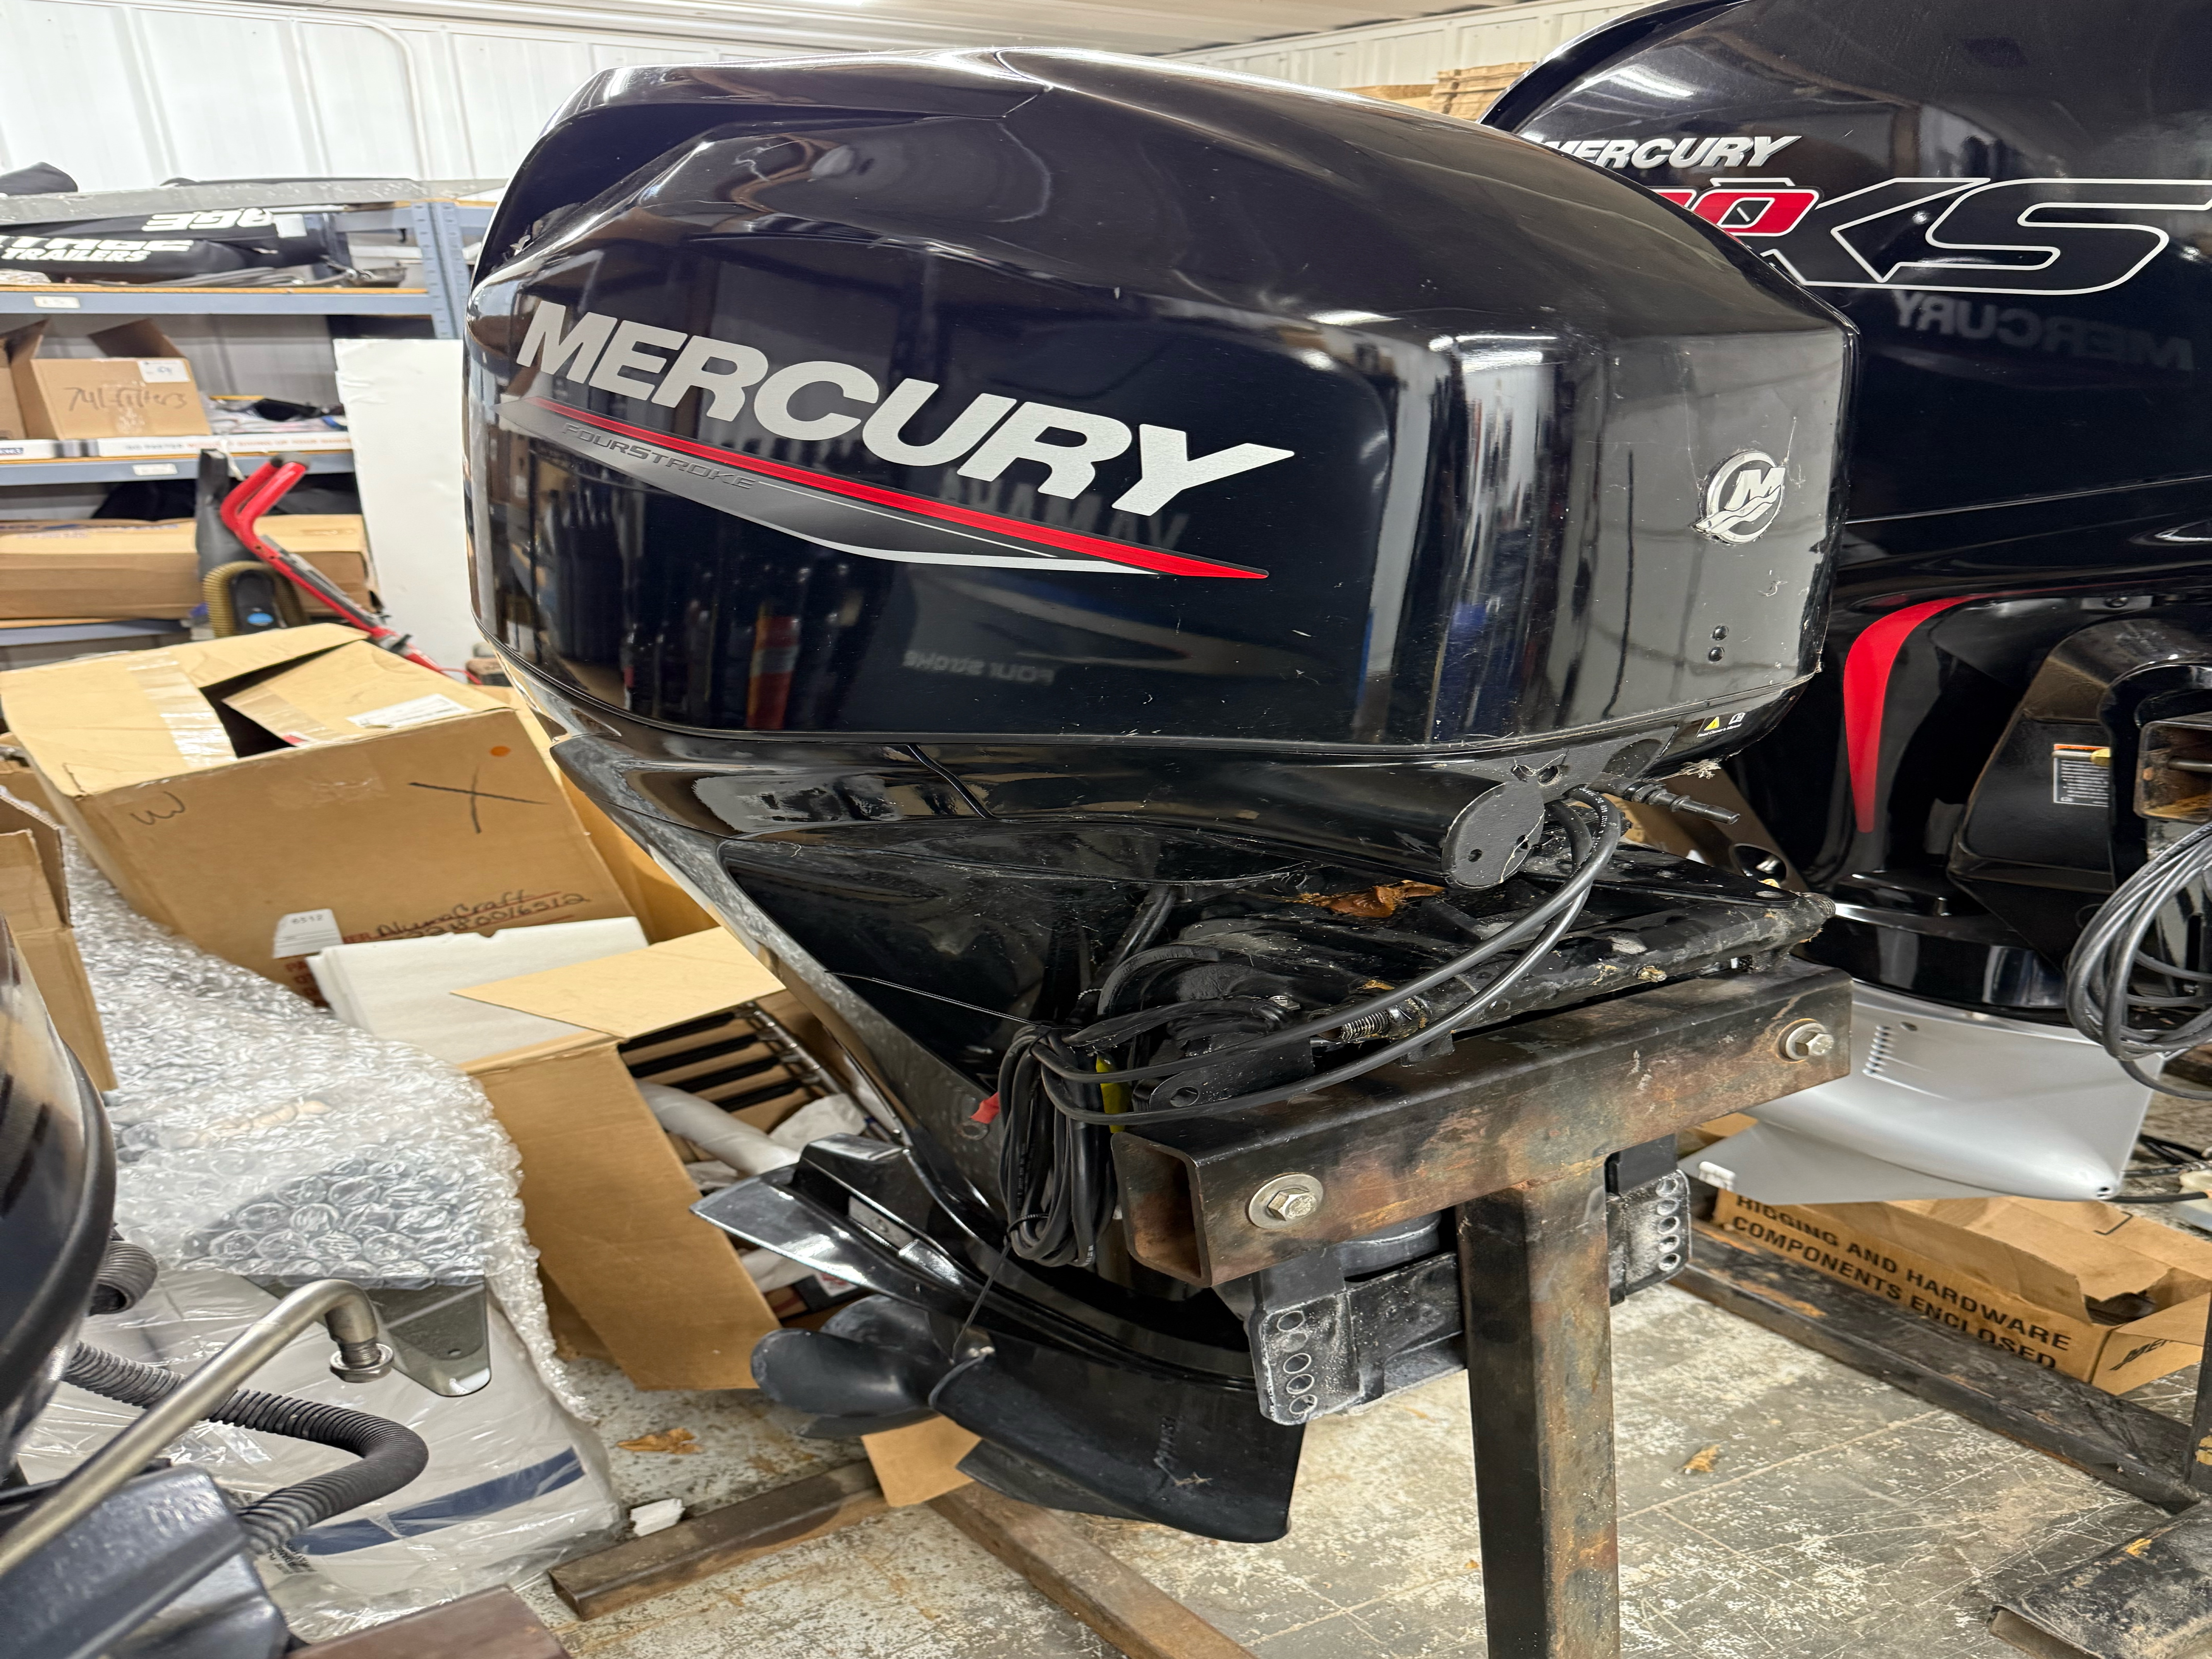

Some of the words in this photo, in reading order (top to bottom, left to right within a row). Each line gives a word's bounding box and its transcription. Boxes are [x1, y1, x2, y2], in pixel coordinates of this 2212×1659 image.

[516, 301, 1296, 517] MERCURY
[562, 422, 757, 489] FOURSTROKE
[1732, 1216, 1903, 1301] COMPONENTS
[1846, 1242, 1898, 1274] AND
[1906, 1269, 2072, 1351] HARDWARE
